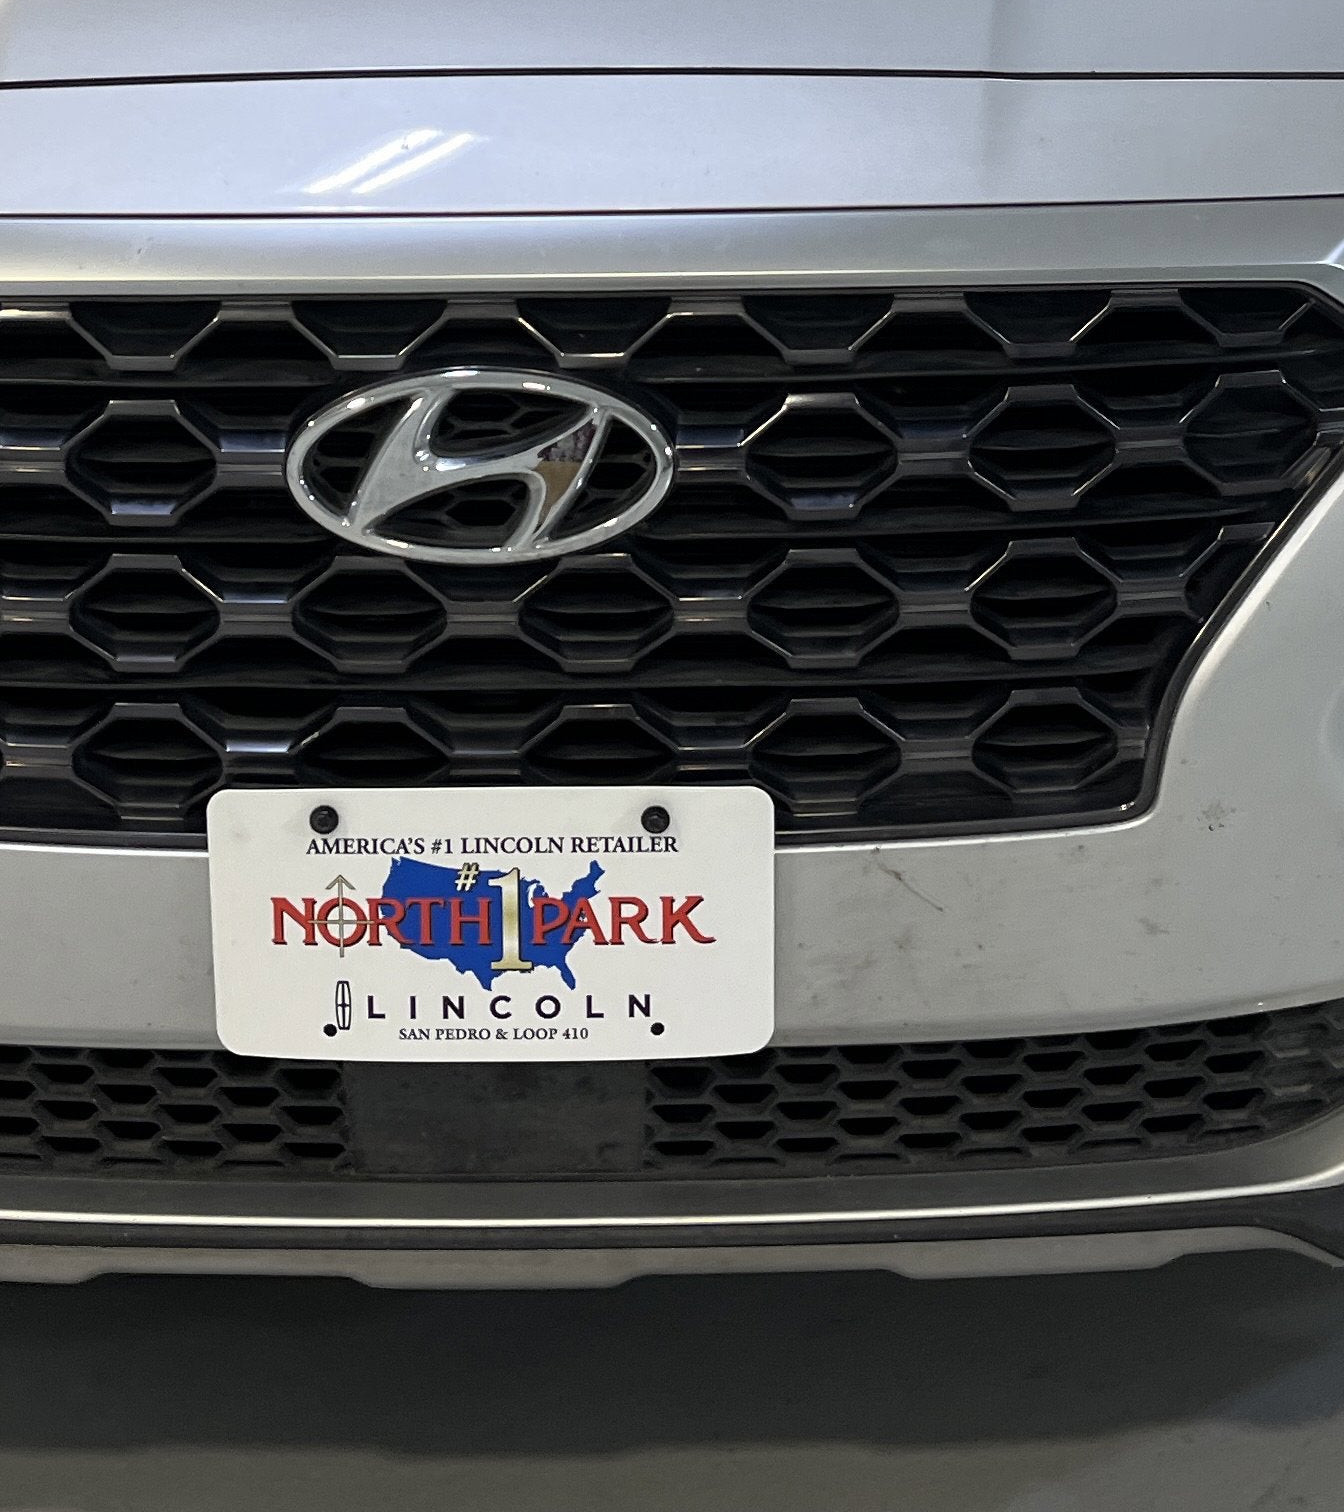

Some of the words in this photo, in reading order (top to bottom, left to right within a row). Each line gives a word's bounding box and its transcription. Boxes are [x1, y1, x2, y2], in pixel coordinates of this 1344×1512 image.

[306, 837, 425, 855] AMERICA'S
[431, 838, 454, 855] #1
[460, 836, 565, 855] LINCOLN
[570, 835, 679, 854] RETAILER
[271, 896, 494, 947] NORTH
[531, 894, 716, 946] PARK
[367, 994, 651, 1021] LINCOLN
[398, 1028, 431, 1041] SAN
[435, 1028, 491, 1041] PEDRO
[495, 1028, 509, 1041] &
[512, 1027, 558, 1041] LOOP
[562, 1027, 589, 1040] 410
